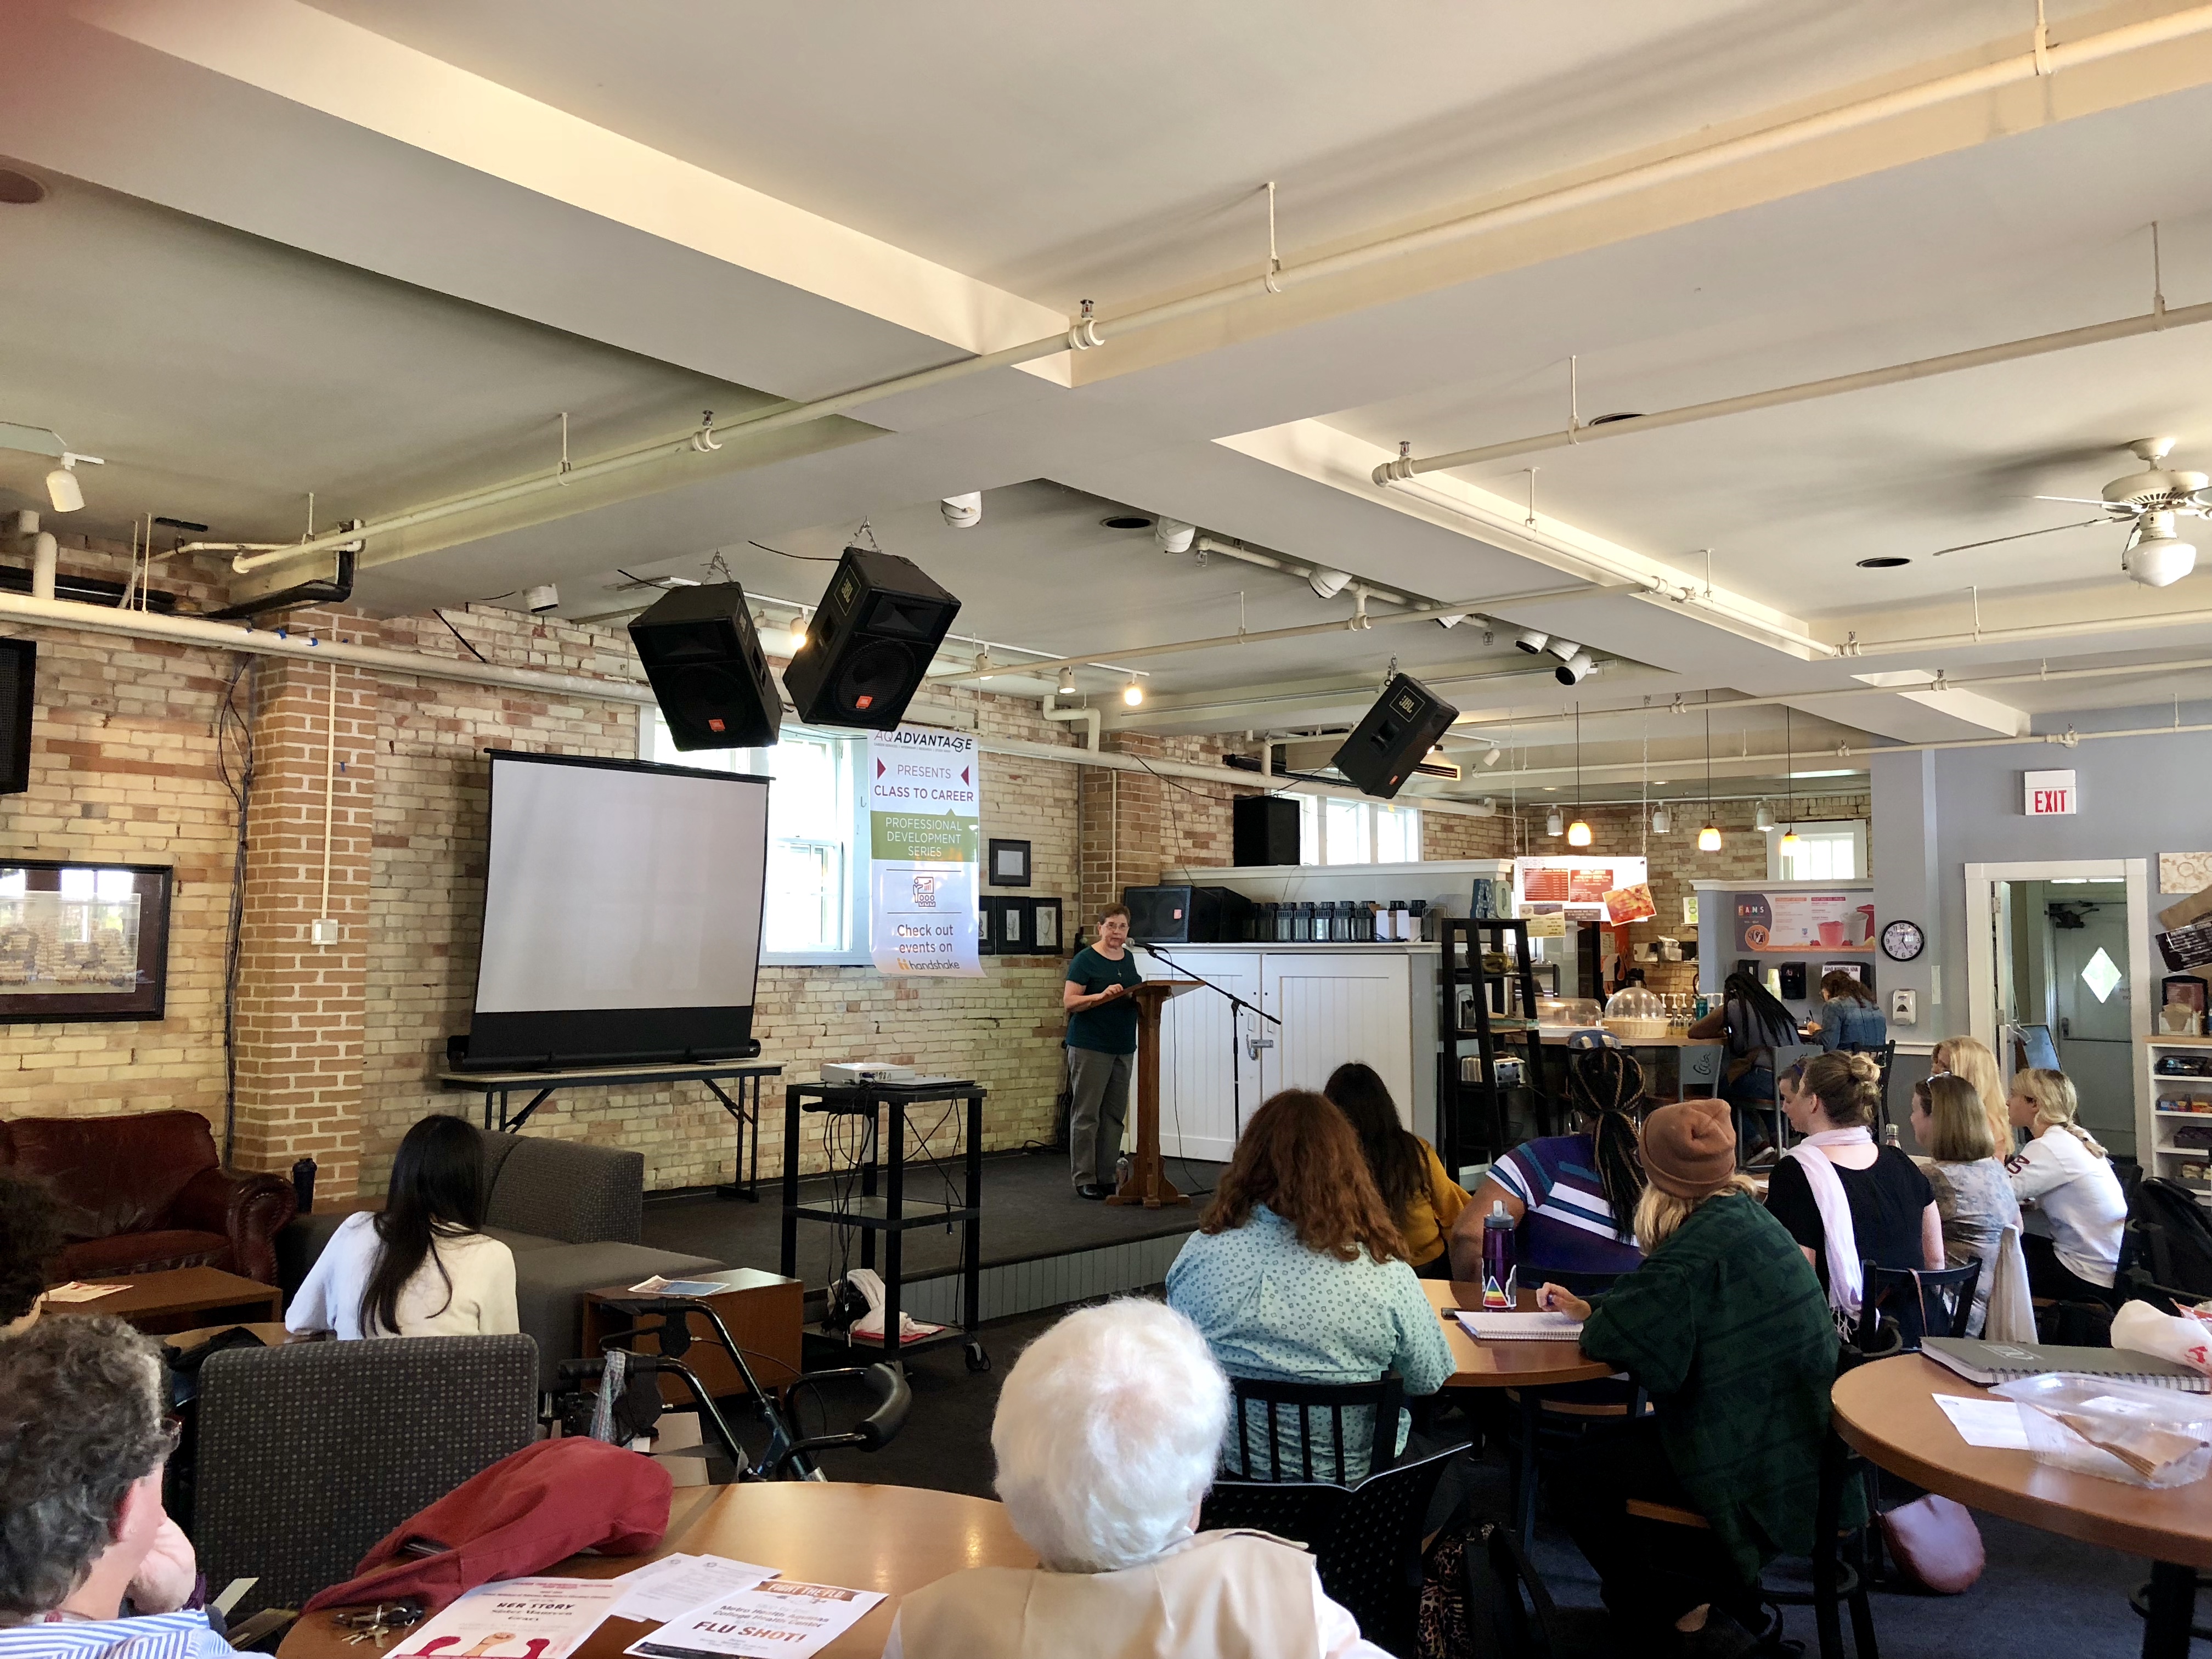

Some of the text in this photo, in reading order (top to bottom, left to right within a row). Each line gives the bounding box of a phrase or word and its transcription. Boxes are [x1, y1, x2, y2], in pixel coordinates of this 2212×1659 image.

[842, 578, 853, 603] JBL
[1399, 695, 1414, 713] JBL
[898, 764, 951, 779] PRESENTS
[874, 785, 974, 802] CLASS TO CAREER
[2034, 790, 2067, 812] EXIT
[885, 817, 962, 831] PROFESSIONAL
[887, 831, 961, 844] DEVELOPMENT
[908, 846, 941, 856] SERIES
[897, 924, 953, 936] Check out
[1899, 924, 1905, 932] 12
[899, 941, 952, 953] events on
[909, 959, 960, 970] handshake
[768, 1584, 802, 1593] FIGHT
[801, 1587, 824, 1596] THE
[713, 1610, 751, 1618] College
[752, 1609, 785, 1617] Health
[692, 1621, 737, 1634] FLU
[737, 1627, 808, 1643] SHOT!
